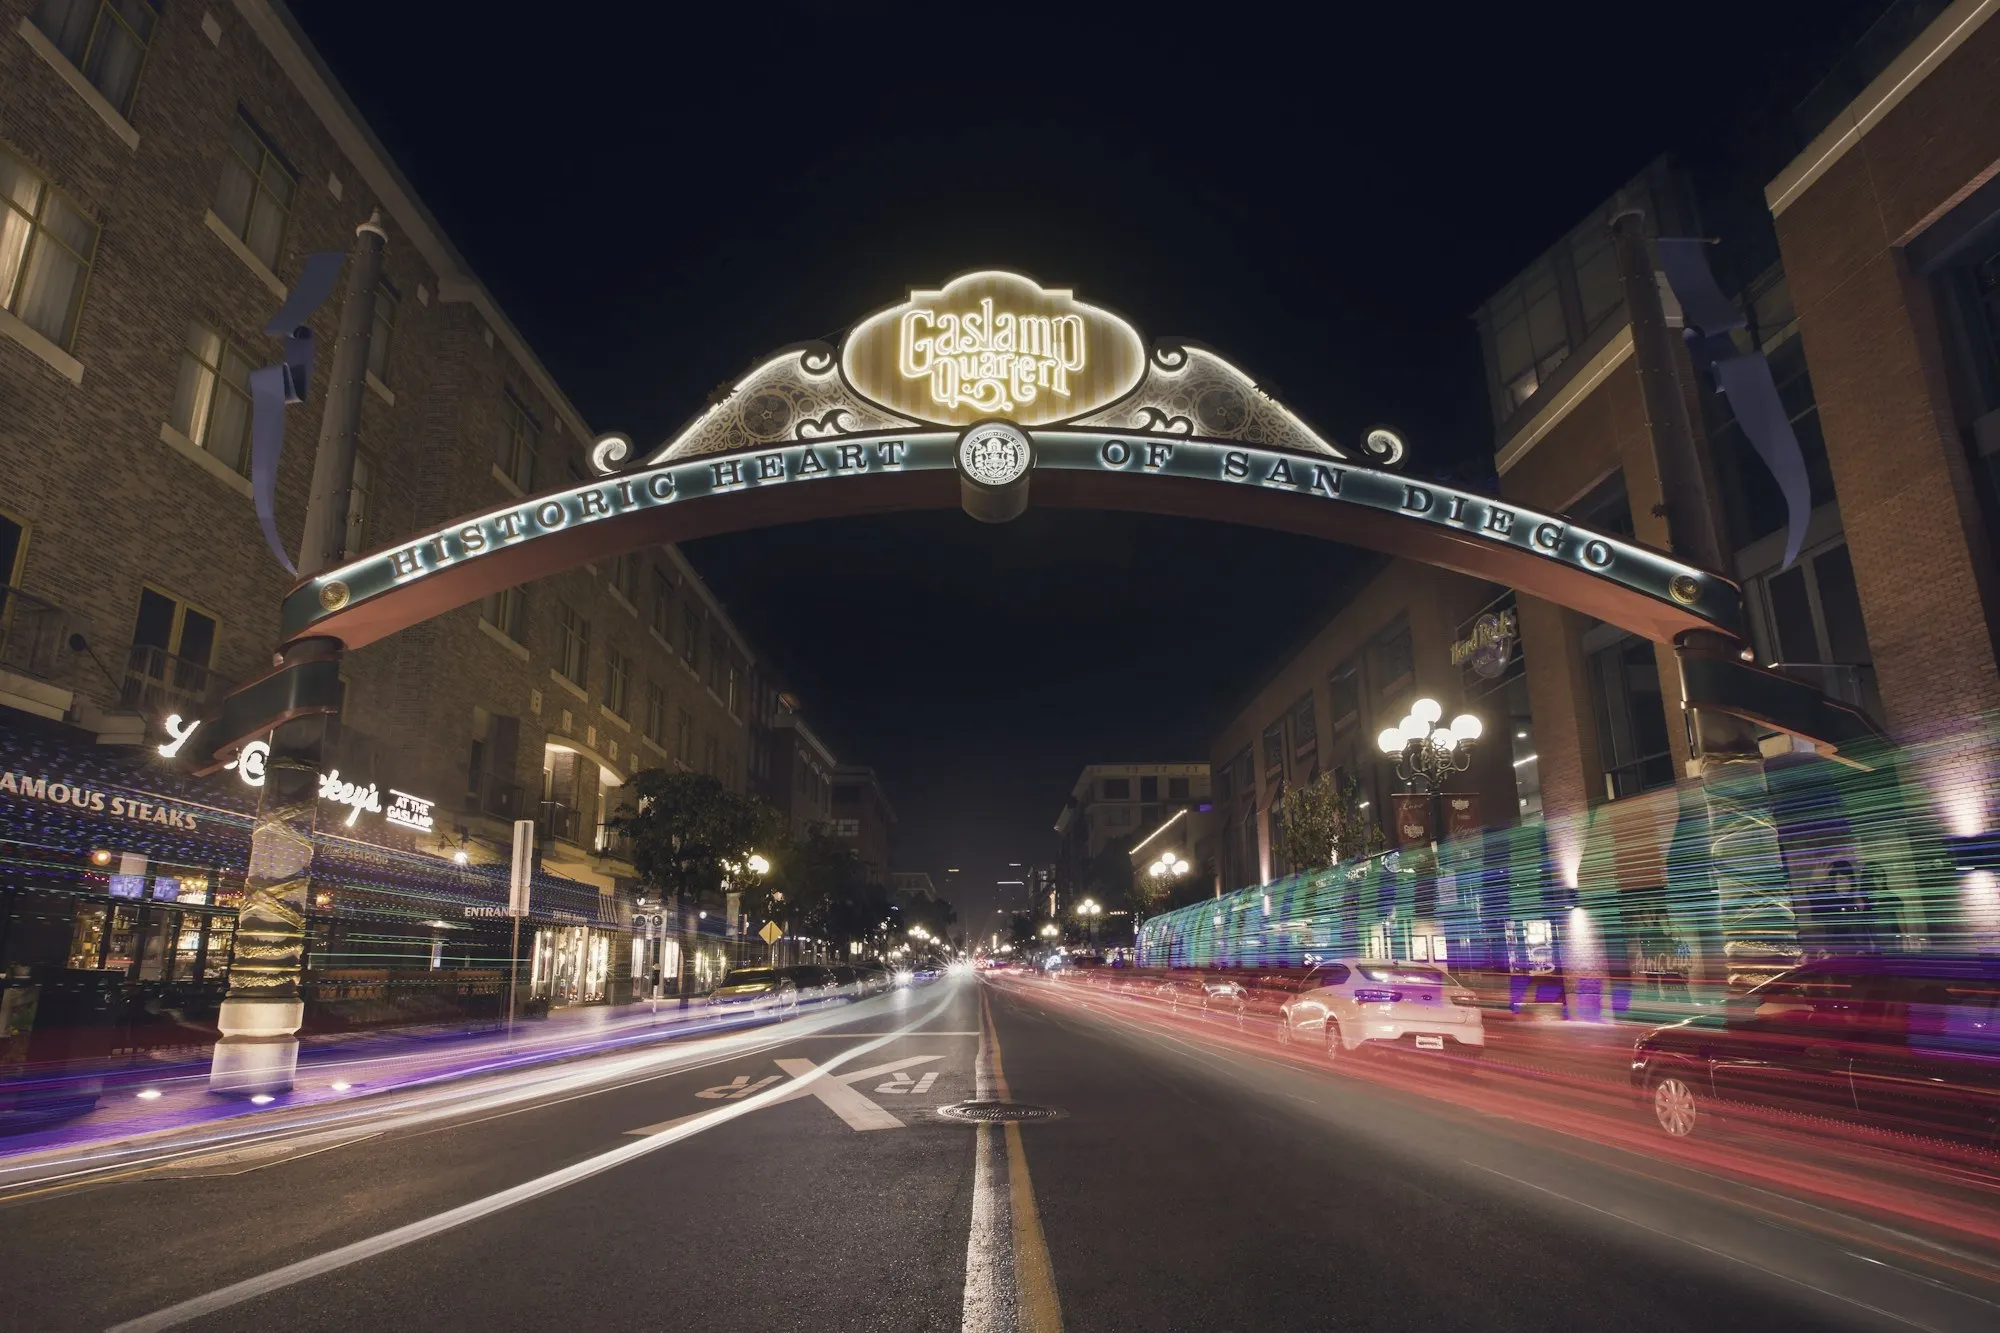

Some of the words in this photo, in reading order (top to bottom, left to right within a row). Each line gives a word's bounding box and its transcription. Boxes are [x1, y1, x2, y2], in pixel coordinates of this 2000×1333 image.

[899, 298, 1086, 380] Gaslamp
[930, 350, 1071, 413] Quarter
[387, 471, 677, 585] HISTORIC
[710, 440, 906, 490] HEART
[1101, 439, 1173, 472] OF
[1223, 450, 1347, 497] SAN
[1401, 483, 1615, 570] DIEGO
[0, 771, 106, 812] AMOUS
[110, 796, 199, 831] STEAKS
[387, 805, 434, 828] GASLAMP
[395, 796, 410, 810] AT
[410, 800, 429, 816] THE
[464, 905, 517, 918] ENTRAN
